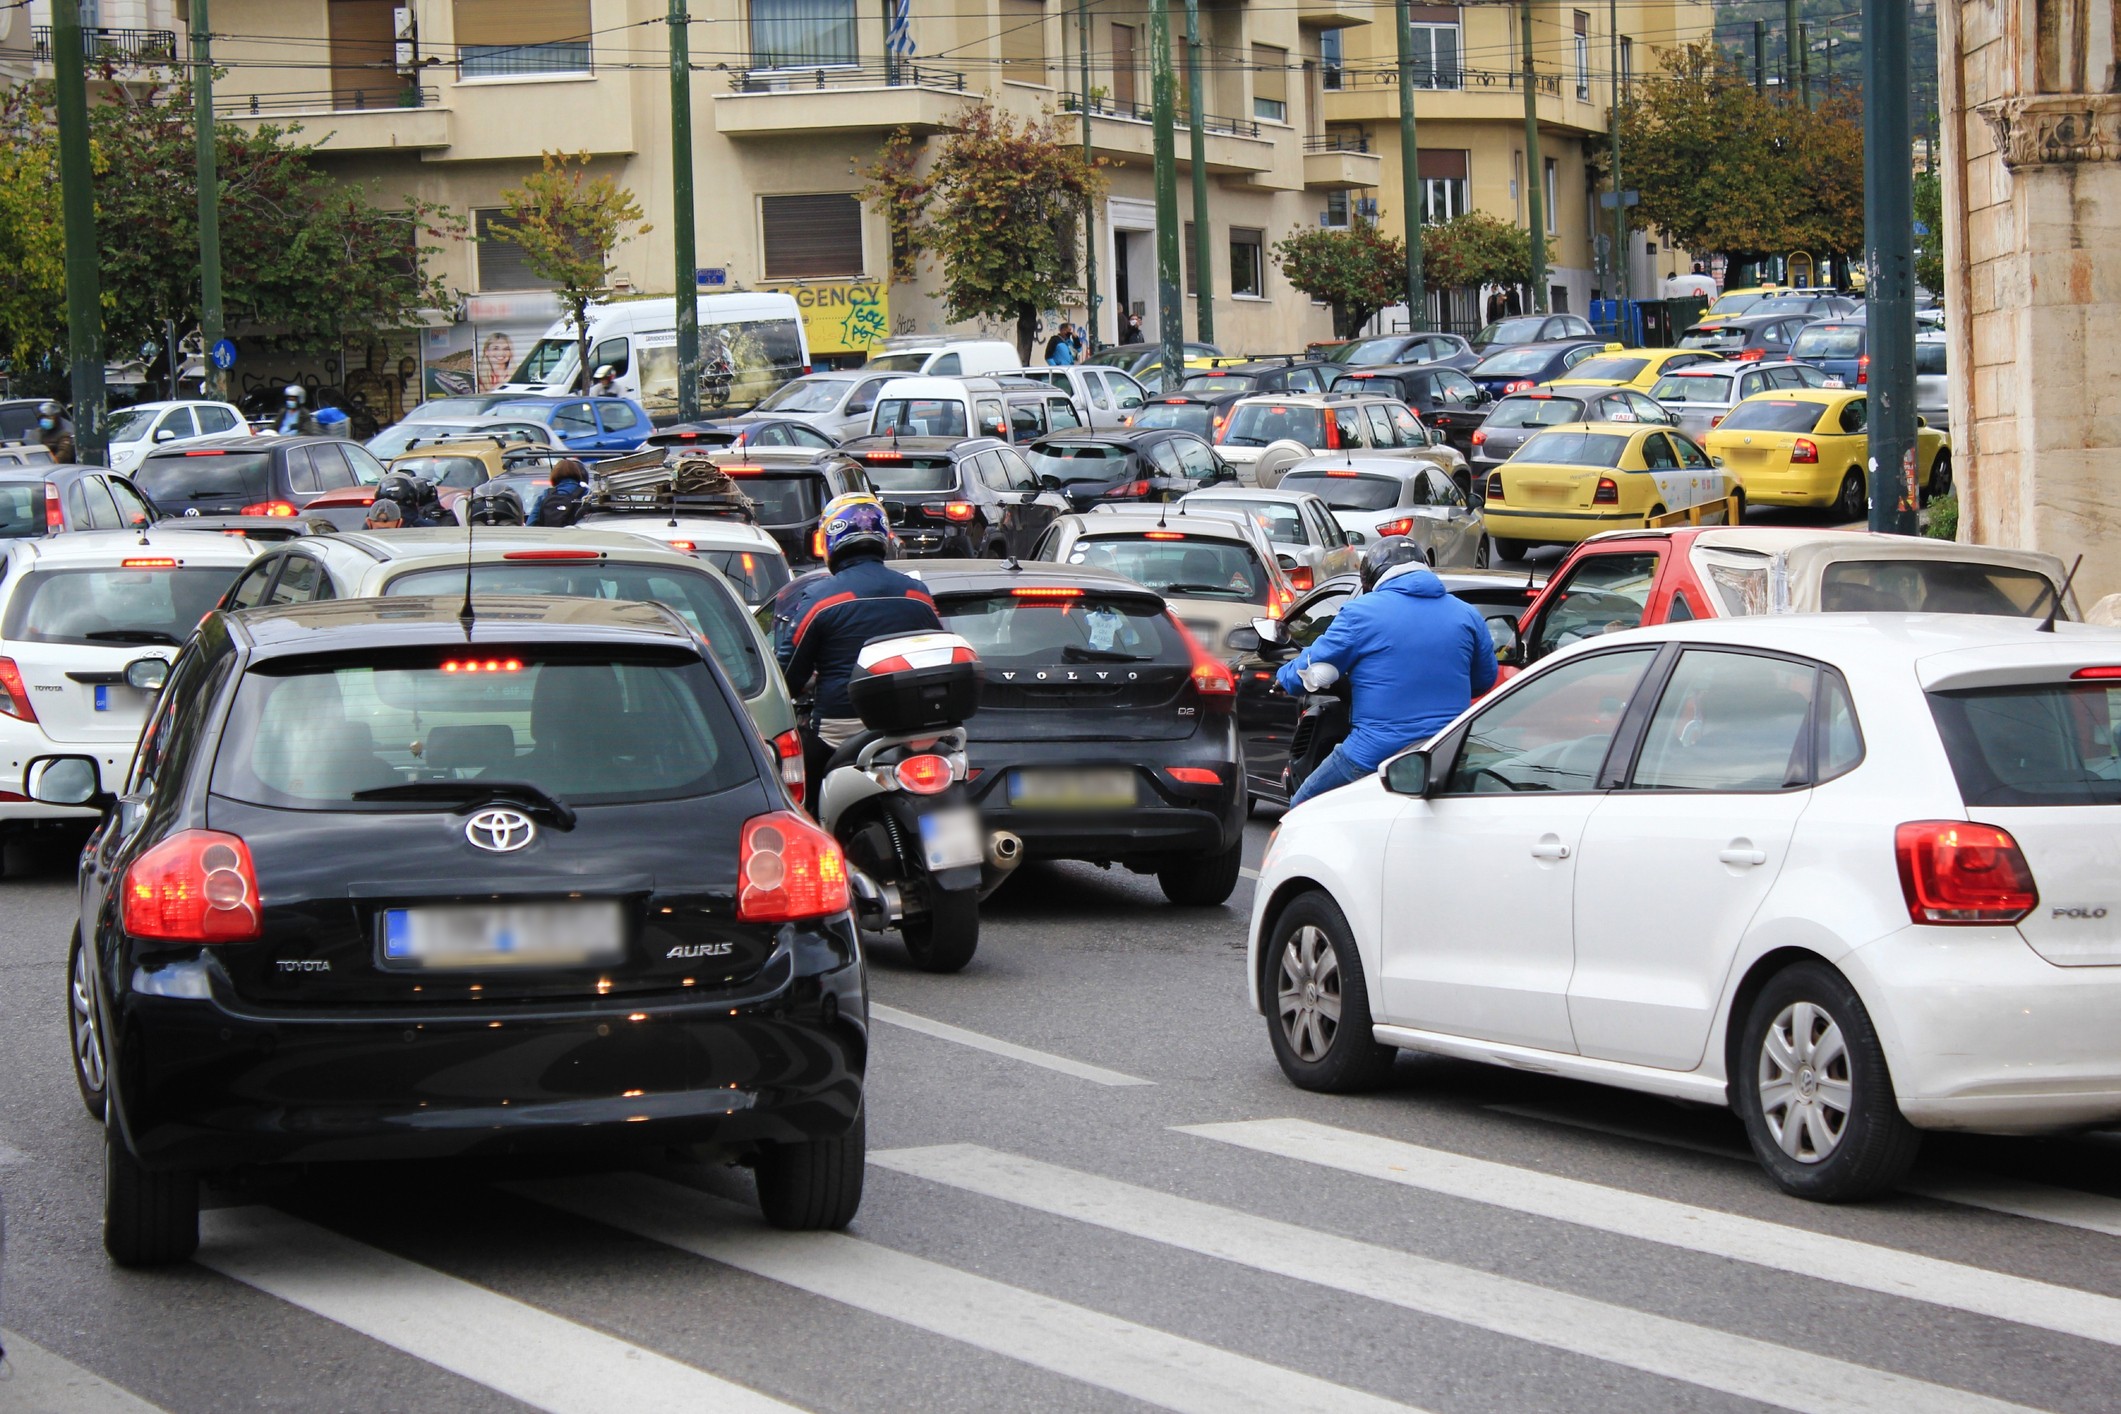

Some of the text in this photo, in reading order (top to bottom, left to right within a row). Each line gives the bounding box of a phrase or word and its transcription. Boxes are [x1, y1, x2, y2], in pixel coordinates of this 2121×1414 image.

[786, 285, 879, 307] GENCY
[1002, 671, 1138, 680] VOLVO
[1177, 707, 1195, 715] D2
[2051, 906, 2107, 919] POLO
[666, 942, 733, 959] AURIS
[276, 961, 331, 972] TOYOTA
